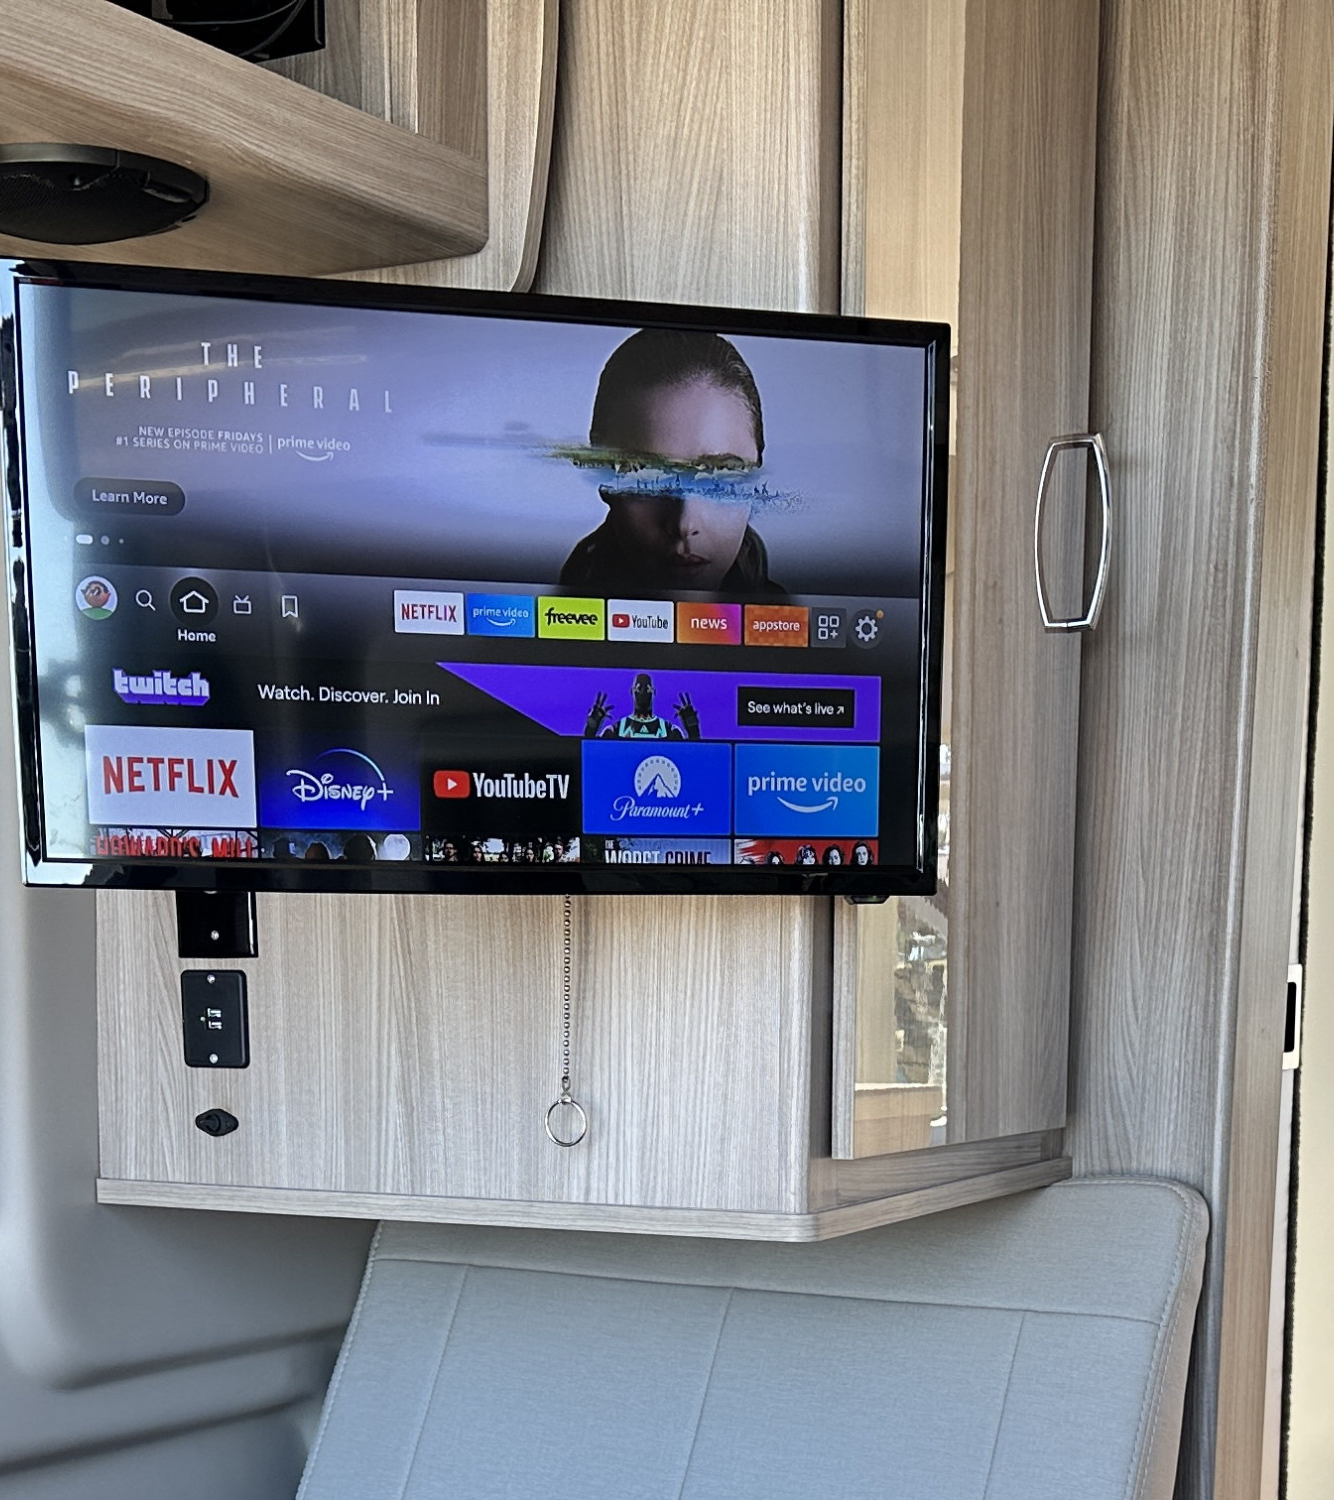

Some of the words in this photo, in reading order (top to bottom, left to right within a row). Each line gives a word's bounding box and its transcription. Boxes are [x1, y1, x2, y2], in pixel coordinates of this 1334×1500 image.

[201, 341, 263, 369] THE
[68, 371, 393, 413] PERIPHERAL
[139, 426, 164, 437] NEW
[168, 428, 214, 440] EPISODE
[218, 430, 263, 443] FRIDAYS
[115, 437, 129, 446] #1
[133, 437, 170, 449] SERIES
[173, 438, 190, 449] ON
[194, 440, 227, 452] PRIME
[231, 442, 264, 454] VIDEO
[277, 436, 315, 450] prime
[317, 436, 351, 451] video
[92, 489, 129, 504] Learn
[133, 491, 168, 505] More
[401, 603, 457, 622] NETFLIX
[472, 605, 501, 618] prime
[502, 606, 529, 618] video
[545, 607, 598, 626] freevee
[632, 615, 669, 630] YouTube
[691, 616, 728, 630] news
[752, 619, 801, 632] appstore
[178, 629, 216, 642] Home
[113, 667, 210, 704] twitch
[258, 684, 314, 702] Watch.
[319, 686, 389, 704] Discover.
[393, 690, 421, 705] Join
[426, 690, 440, 705] In
[747, 701, 770, 713] See
[773, 701, 812, 715] what's
[815, 702, 834, 715] live
[102, 755, 239, 798] NETFLIX
[747, 774, 806, 798] prime
[811, 774, 867, 794] video
[610, 796, 705, 822] Paramount+
